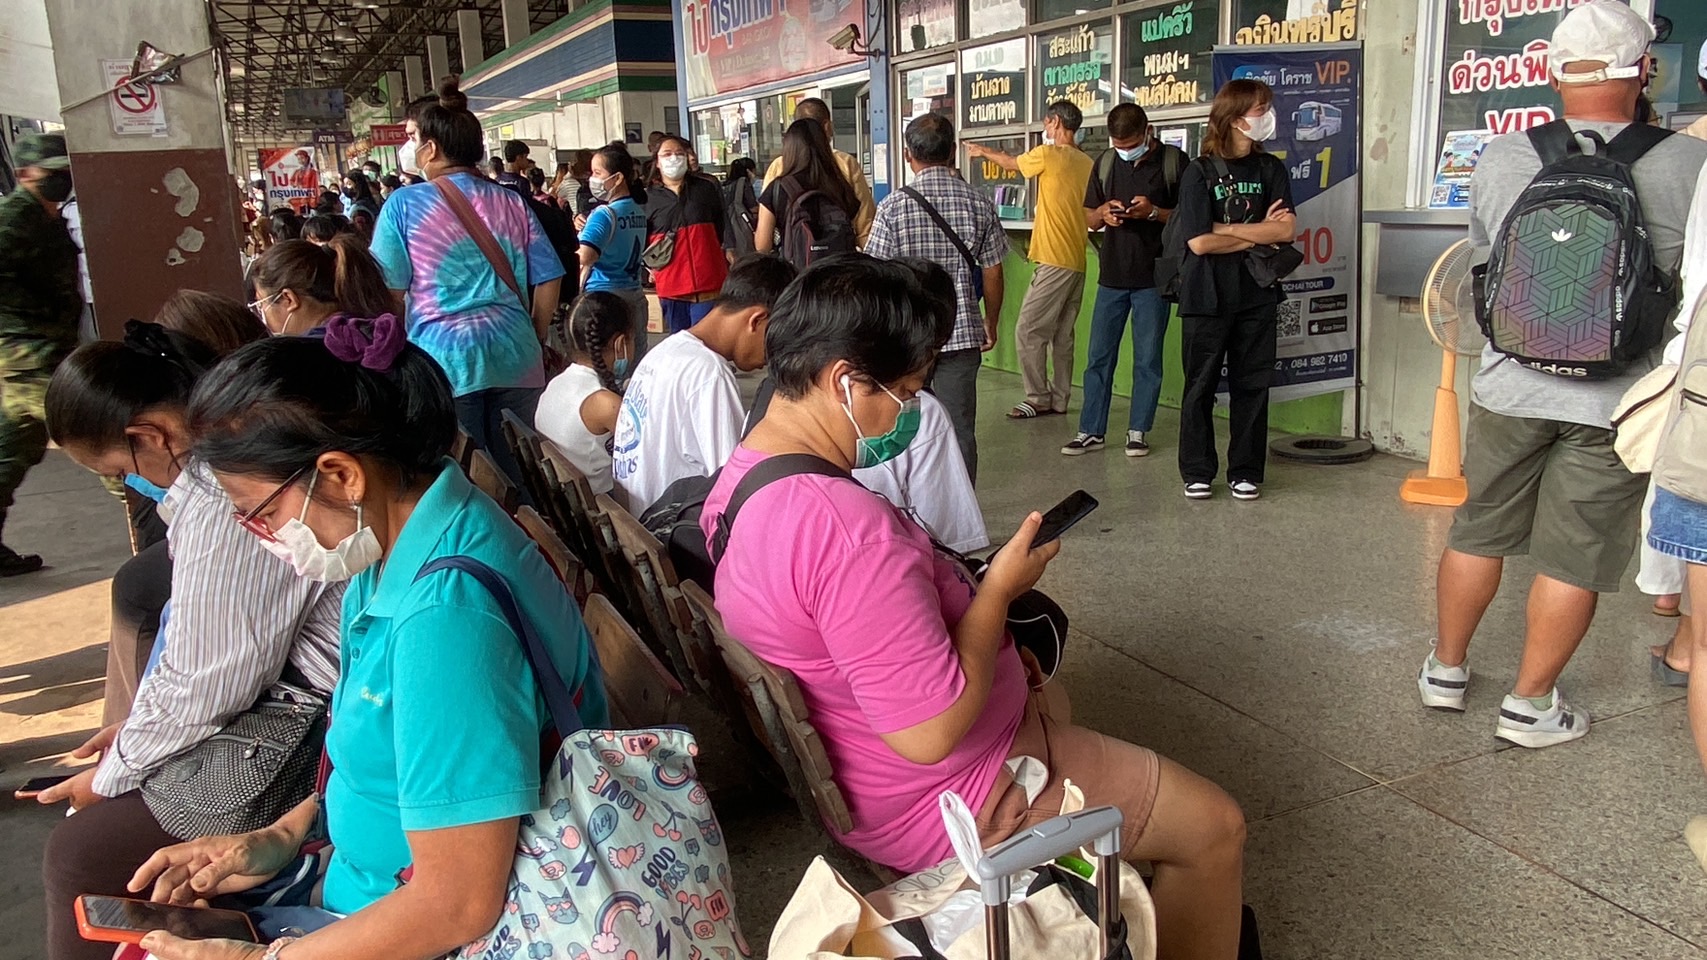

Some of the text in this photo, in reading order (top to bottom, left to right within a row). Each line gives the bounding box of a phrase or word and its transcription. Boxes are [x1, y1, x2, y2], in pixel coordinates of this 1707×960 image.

[687, 3, 708, 55] ไป
[1141, 1, 1194, 43] แปดริ้ว
[1049, 24, 1095, 58] สระแก้ว
[1143, 49, 1190, 77] พนมฯ
[1280, 68, 1312, 86] โคราช
[1451, 40, 1551, 92] ด่วนพิ
[971, 73, 1011, 100] บ้านฉาง
[1134, 74, 1198, 107] พนัสนิคม
[968, 100, 1016, 125] มาบตาพุด
[1486, 108, 1554, 135] VIP
[318, 135, 336, 143] ATM
[267, 171, 289, 188] ไป
[1291, 147, 1332, 189] ฟรี 1
[1296, 226, 1334, 265] 10
[1282, 280, 1324, 292] DCHAI TOUR
[587, 765, 647, 821] LOVE
[641, 846, 676, 888] GOOD
